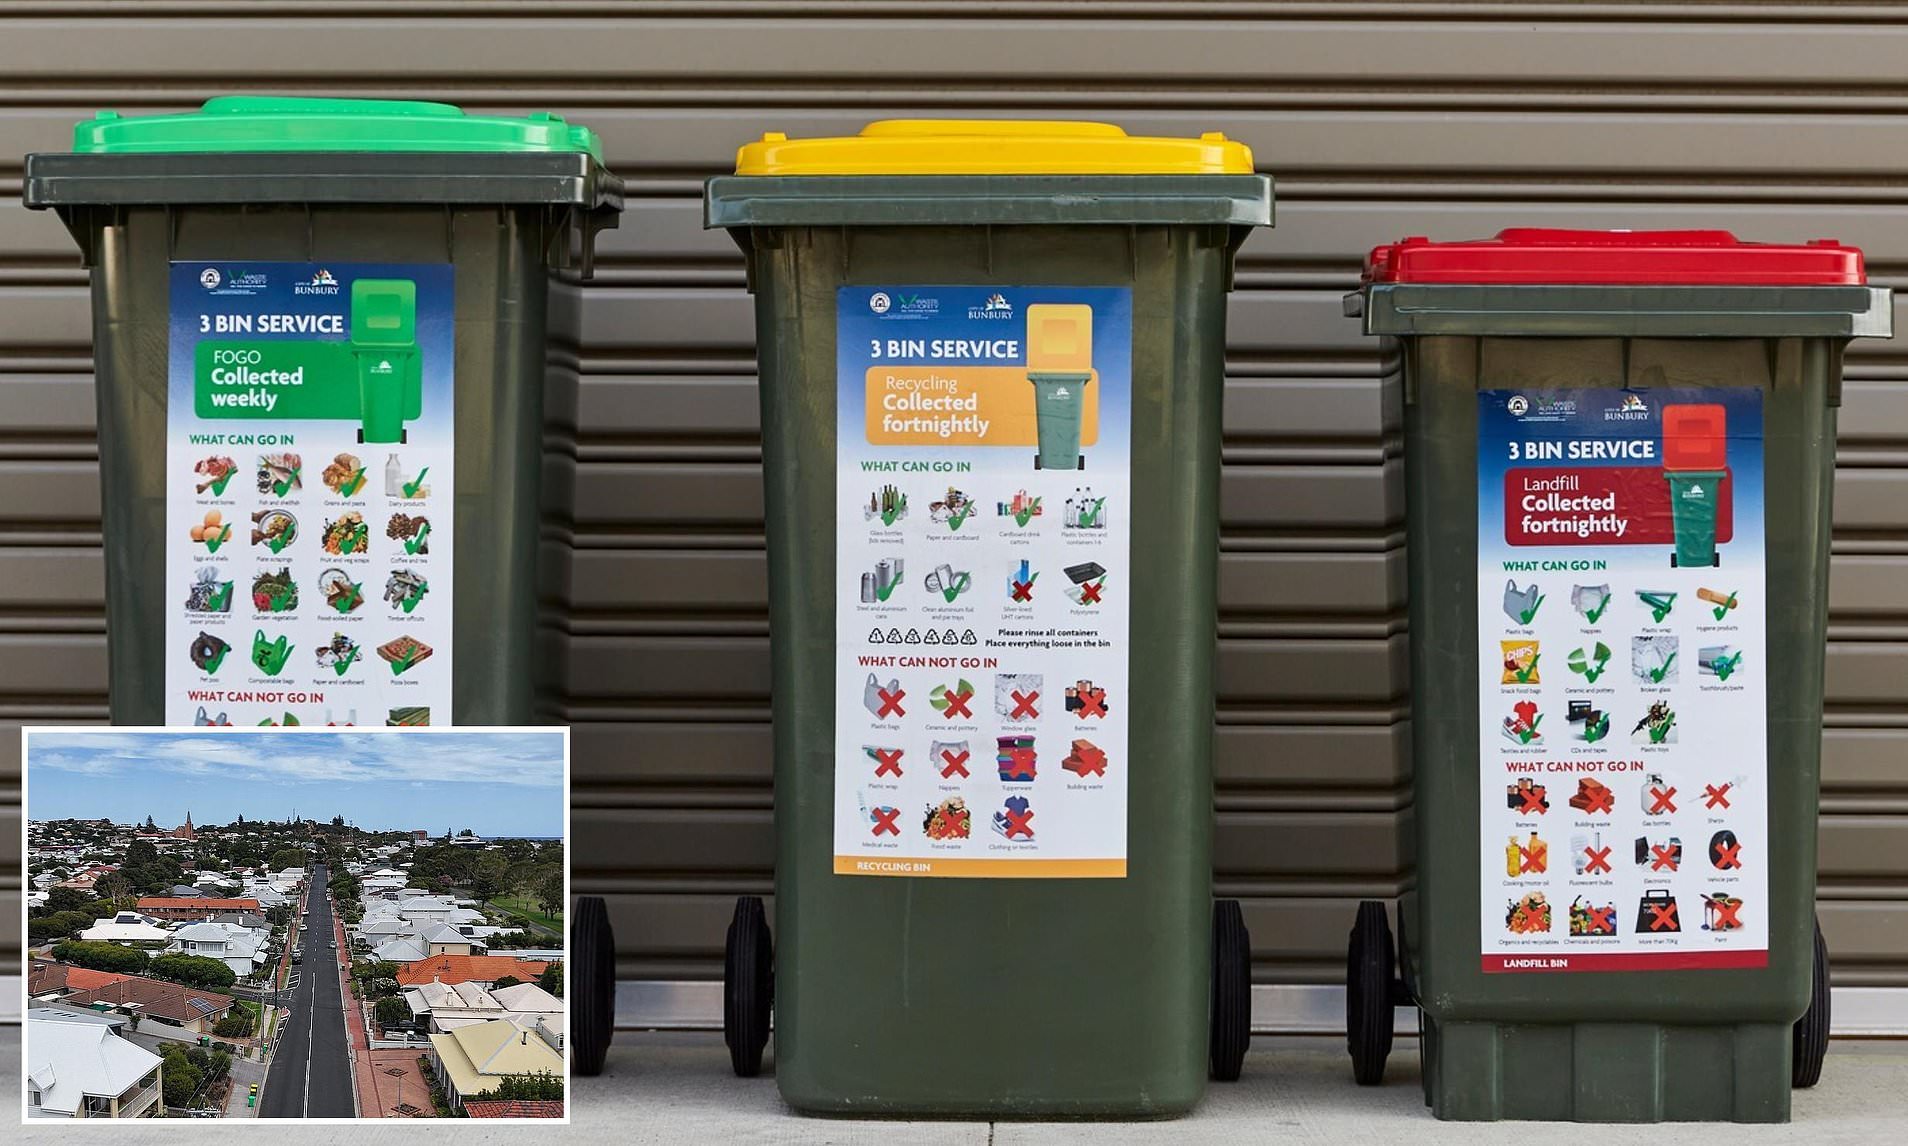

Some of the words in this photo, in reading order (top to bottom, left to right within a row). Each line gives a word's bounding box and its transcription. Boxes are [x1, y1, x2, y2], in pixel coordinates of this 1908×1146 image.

[294, 286, 340, 295] BUNBURY
[968, 310, 1013, 320] BUNBURY
[200, 315, 211, 333] 3
[216, 315, 251, 333] BIN
[257, 315, 344, 333] SERVICE
[870, 340, 881, 358] 3
[887, 340, 925, 358] BIN
[930, 340, 1018, 358] SERVICE
[214, 350, 261, 364] FOGO
[211, 366, 303, 385] Collected
[885, 376, 958, 394] Recycling
[211, 389, 278, 411] weekly
[883, 393, 977, 411] Collected
[1604, 412, 1649, 421] BUNBURY
[883, 414, 990, 438] fortnightly
[189, 434, 225, 446] WHAT
[228, 434, 254, 446] CAN
[257, 434, 277, 446] GO
[280, 434, 294, 446] IN
[1509, 442, 1520, 460] 3
[1525, 441, 1562, 459] BIN
[1568, 441, 1655, 459] SERVICE
[861, 461, 898, 473] WHAT
[902, 461, 929, 473] CAN
[932, 461, 953, 473] GO
[956, 461, 971, 473] IN
[1524, 476, 1579, 491] Landfill
[1521, 492, 1615, 512] Collected
[1521, 514, 1628, 538] fortnightly
[1503, 561, 1540, 571] WHAT
[1543, 561, 1568, 571] CAN
[1570, 560, 1589, 571] GO
[1592, 560, 1606, 570] IN
[998, 629, 1023, 638] Please
[1025, 629, 1042, 638] rinse
[1043, 629, 1055, 638] all
[1057, 629, 1098, 638] containers
[985, 639, 1007, 648] Place
[1008, 639, 1050, 649] everything
[1052, 639, 1072, 648] loose
[1073, 639, 1081, 648] in
[1083, 639, 1096, 648] the
[1098, 640, 1111, 648] bin
[1506, 645, 1533, 661] CHIPS
[858, 656, 895, 667] WHAT
[899, 656, 927, 667] CAN
[929, 657, 958, 668] NOT
[960, 658, 981, 668] GO
[984, 658, 997, 668] IN
[187, 690, 224, 702] WHAT
[227, 691, 253, 702] CAN
[256, 692, 285, 703] NOT
[287, 692, 307, 703] GO
[310, 692, 324, 703] IN
[1505, 762, 1544, 773] WHAT
[1547, 762, 1573, 772] CAN
[1576, 762, 1604, 772] NOT
[1607, 761, 1627, 771] GO
[1630, 761, 1643, 771] IN
[857, 861, 912, 872] RECYCLING
[913, 861, 931, 872] BIN
[1503, 959, 1550, 969] LANDFILL
[1550, 959, 1568, 969] BIN
